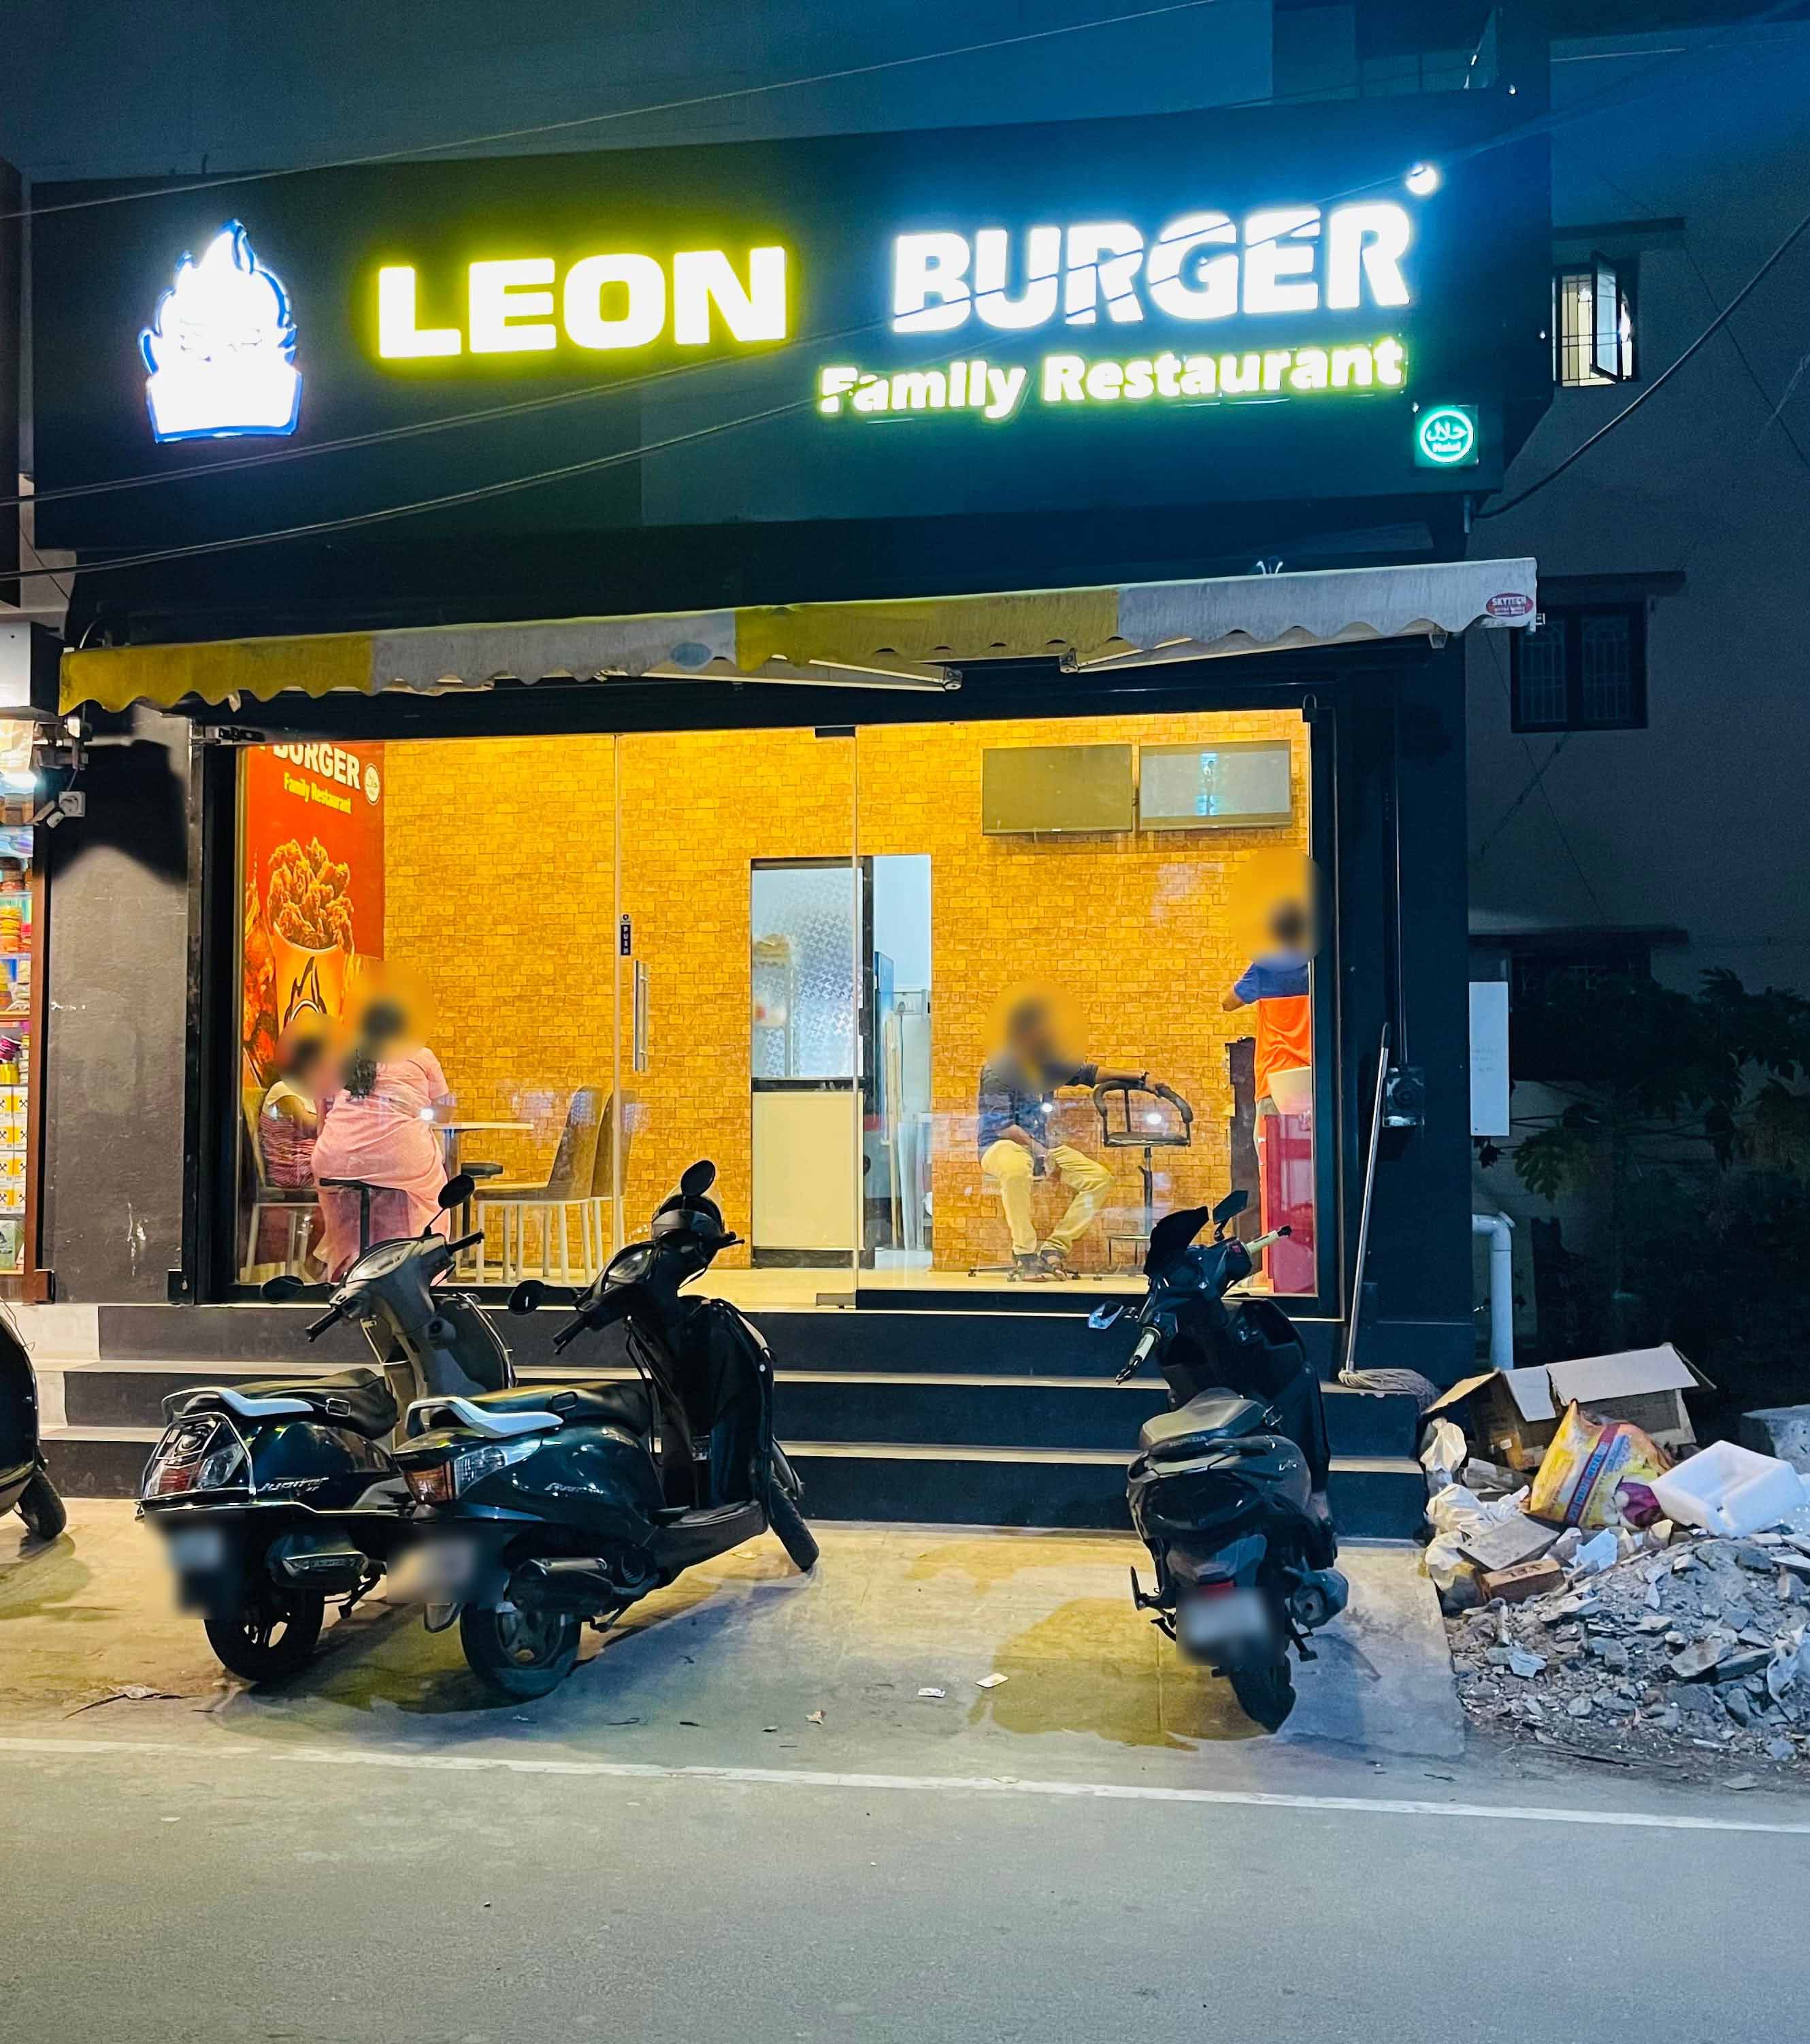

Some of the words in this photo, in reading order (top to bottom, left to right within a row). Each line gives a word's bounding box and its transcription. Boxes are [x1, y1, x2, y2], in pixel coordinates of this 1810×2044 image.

[378, 246, 787, 359] LEON
[891, 201, 1412, 333] BURGER
[820, 359, 1027, 419] Family
[1042, 336, 1405, 403] Restaurant
[283, 772, 310, 803] Family
[311, 782, 352, 815] Restaurant
